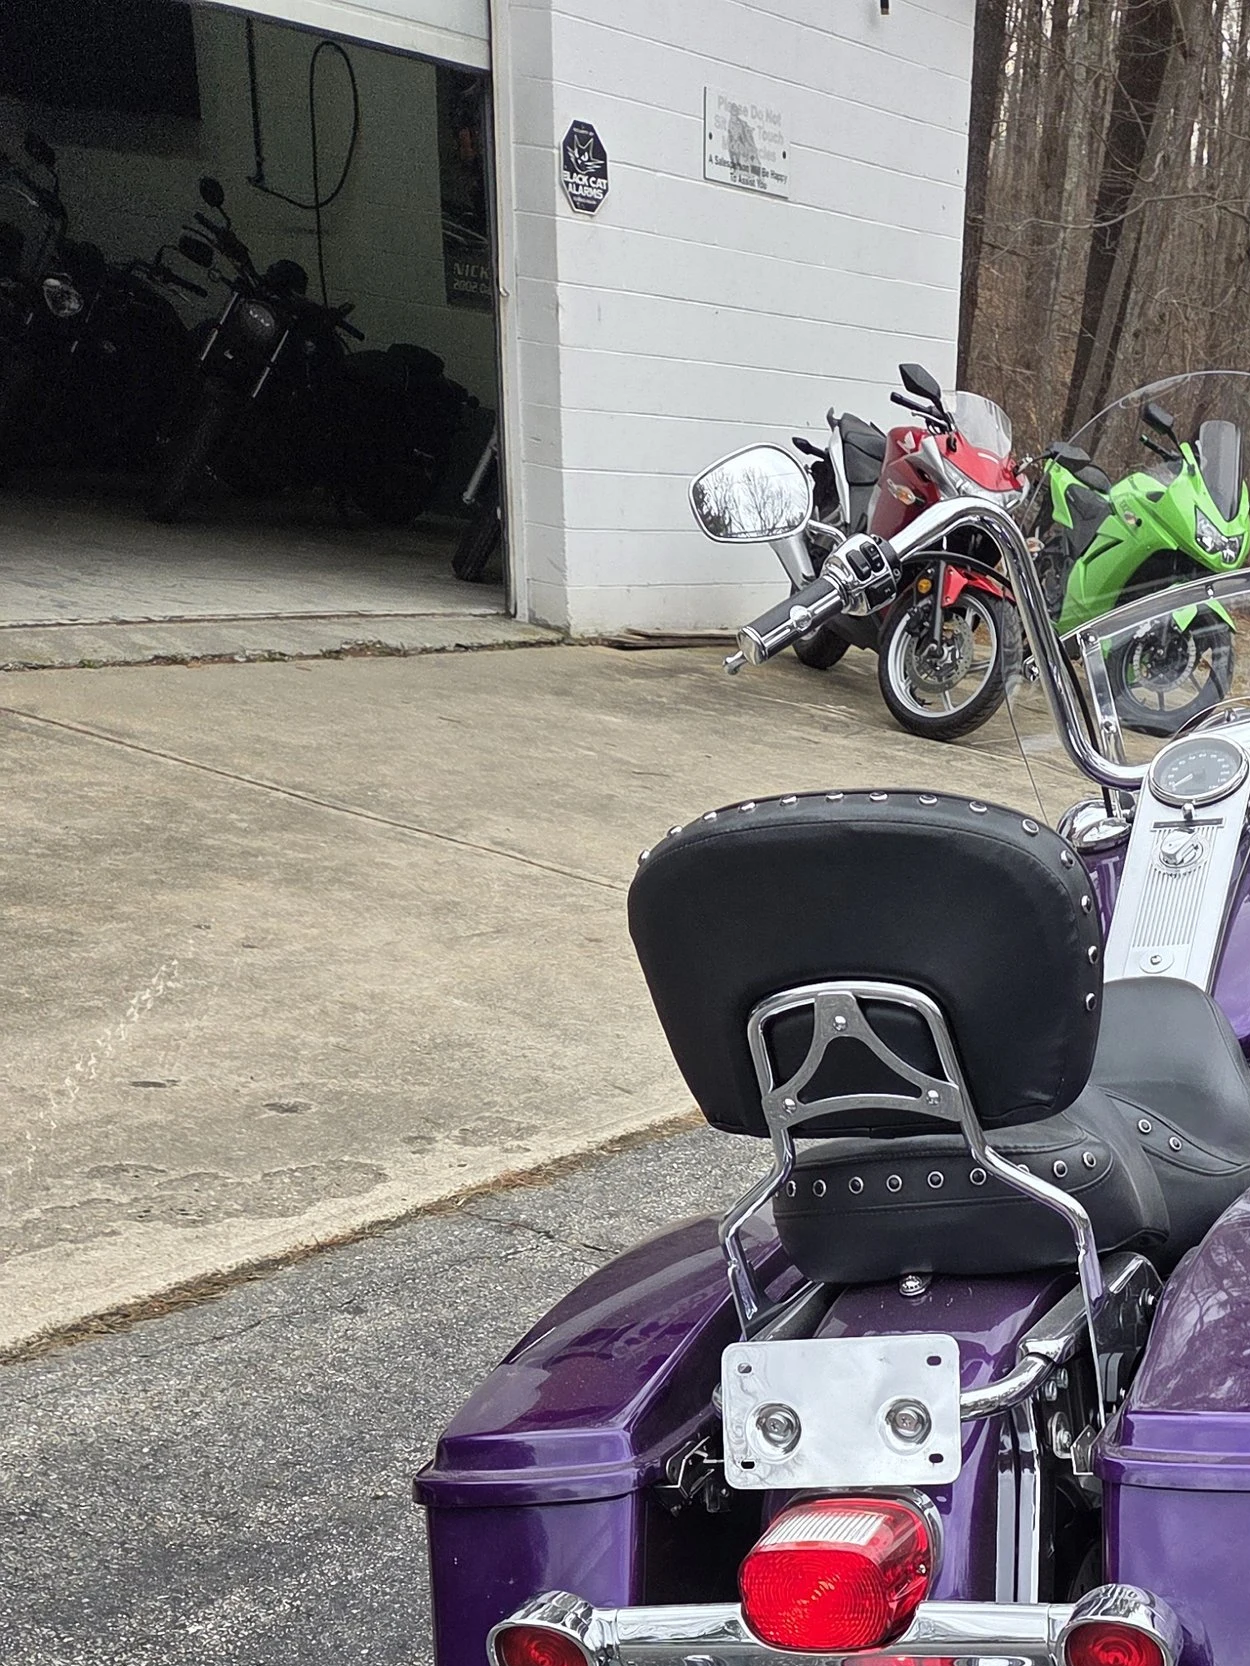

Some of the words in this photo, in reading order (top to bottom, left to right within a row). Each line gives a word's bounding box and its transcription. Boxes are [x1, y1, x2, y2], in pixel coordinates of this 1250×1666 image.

[751, 104, 764, 120] Do
[765, 108, 782, 126] Not
[756, 125, 785, 145] Touch
[563, 170, 589, 186] BLACK
[589, 177, 608, 190] CAT
[567, 183, 604, 200] ALARMS
